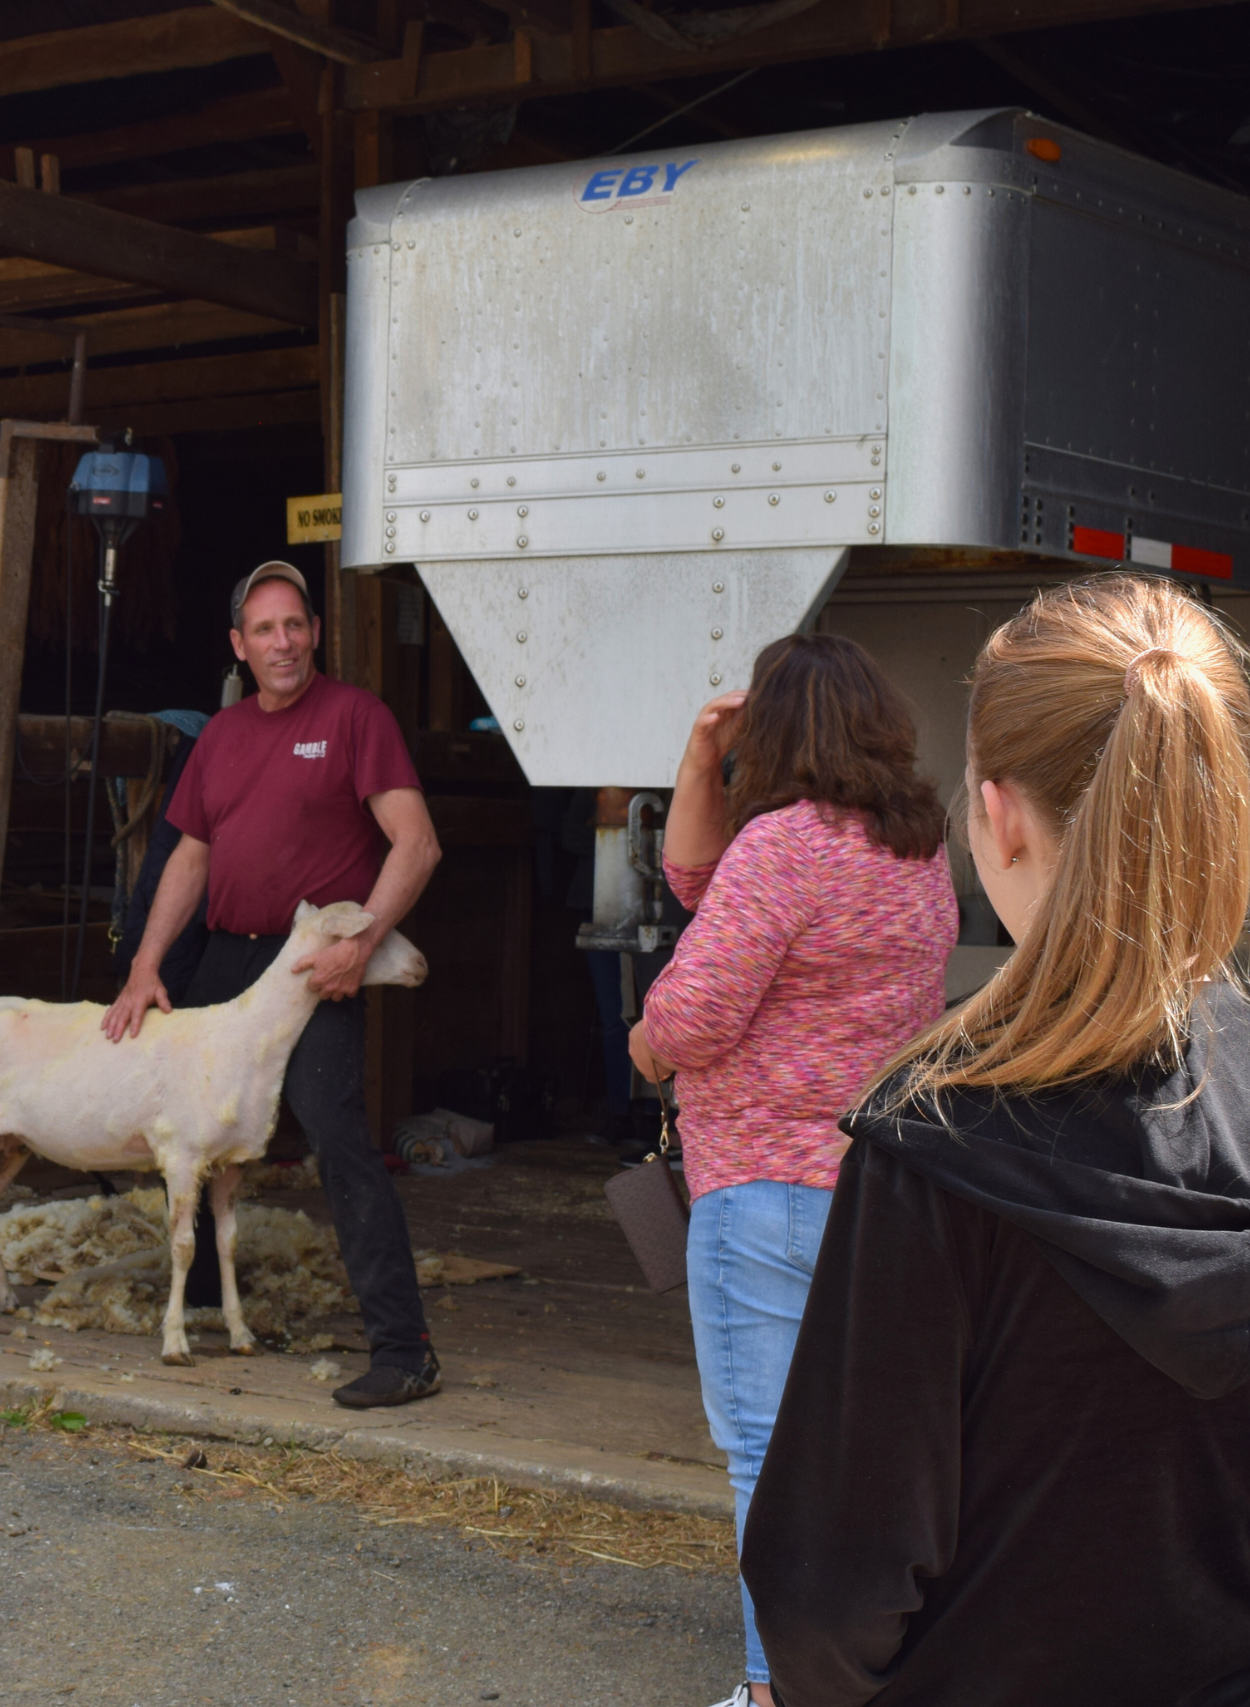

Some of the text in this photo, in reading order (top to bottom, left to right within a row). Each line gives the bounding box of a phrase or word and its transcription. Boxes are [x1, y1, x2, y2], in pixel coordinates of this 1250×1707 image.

[581, 159, 700, 202] EBY
[298, 507, 342, 528] NO SMOKI
